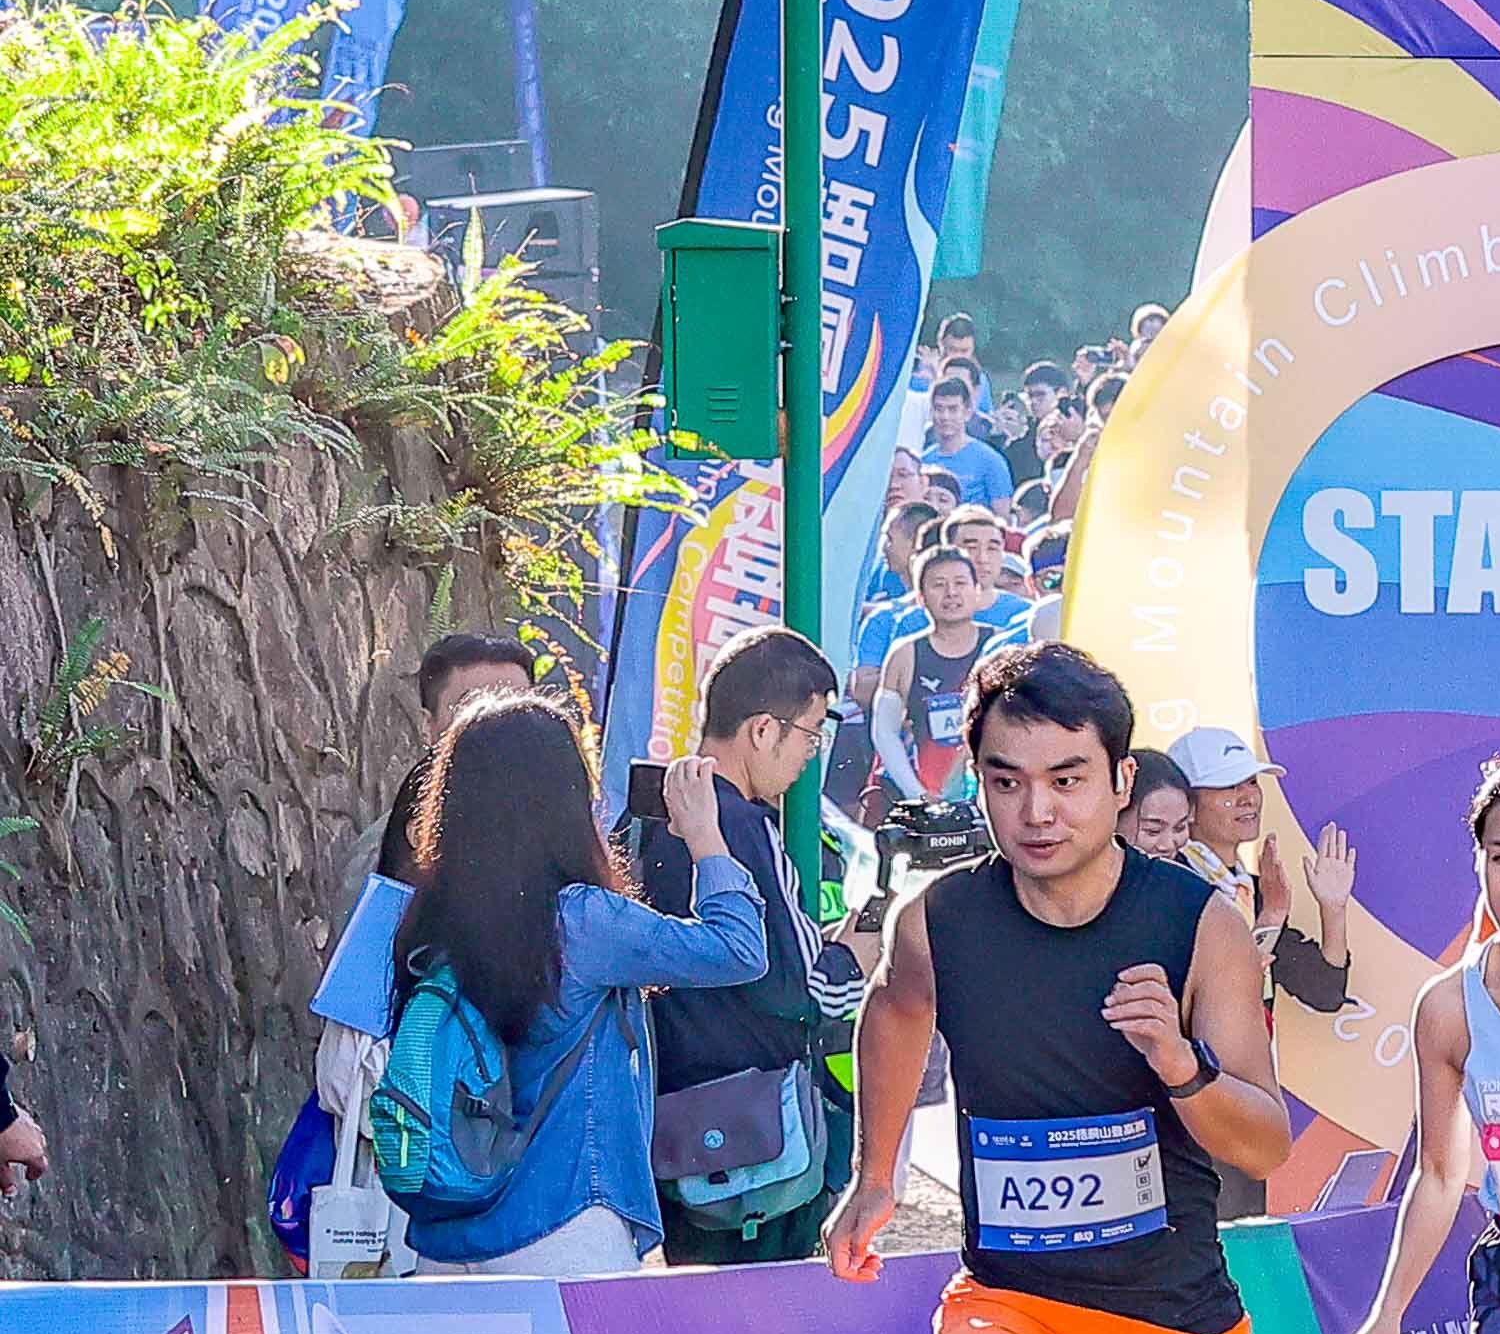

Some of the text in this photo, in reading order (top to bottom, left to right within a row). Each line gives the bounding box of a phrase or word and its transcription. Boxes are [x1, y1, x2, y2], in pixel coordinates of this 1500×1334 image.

[1132, 334, 1297, 656] Mountain
[930, 834, 967, 849] RONIN
[999, 1173, 1105, 1211] A292
